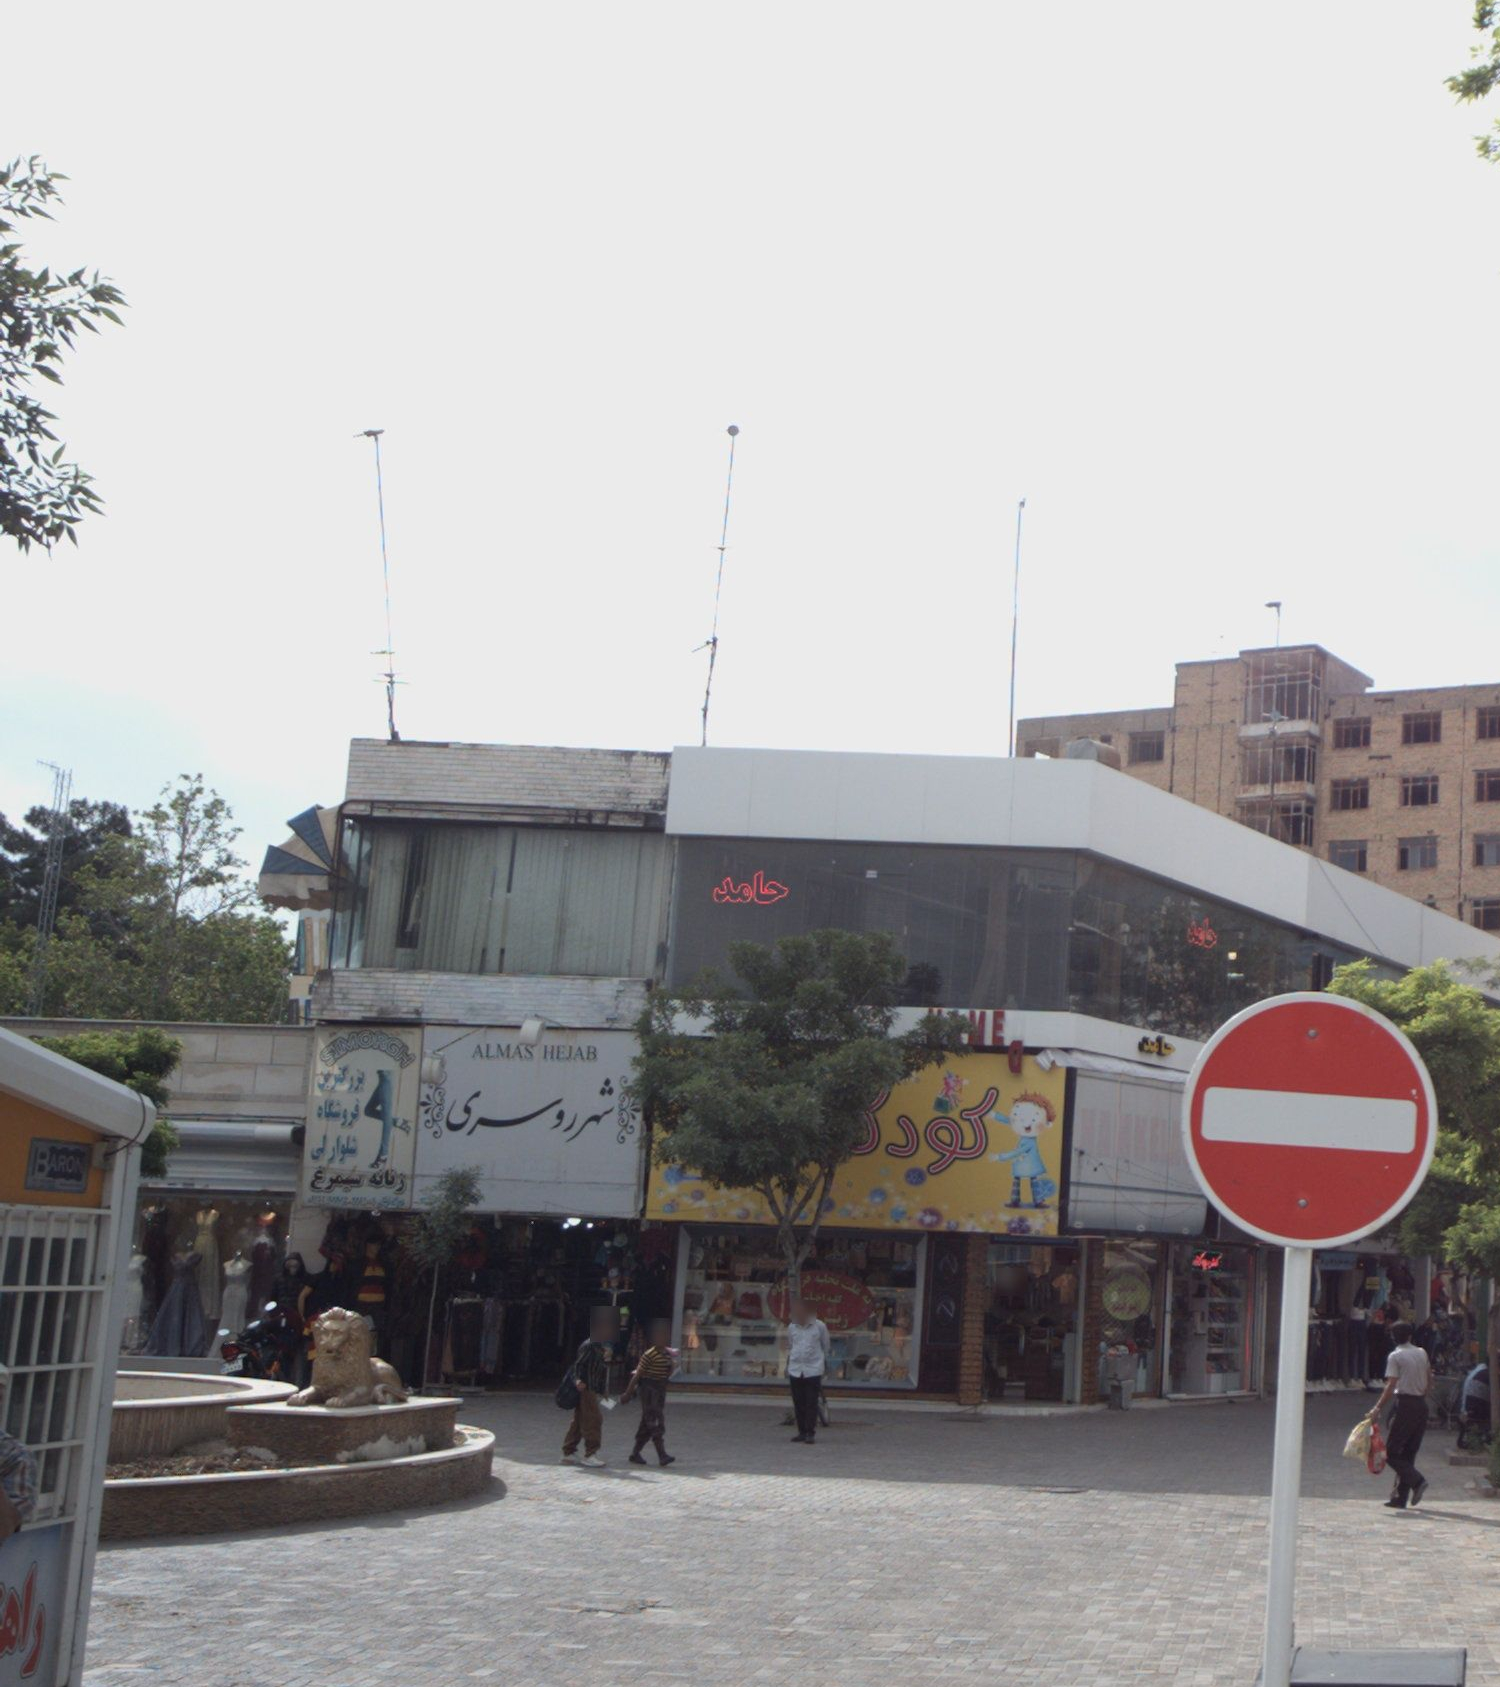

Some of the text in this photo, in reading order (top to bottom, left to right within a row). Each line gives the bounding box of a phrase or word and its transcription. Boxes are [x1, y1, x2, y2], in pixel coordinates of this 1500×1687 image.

[713, 870, 789, 904] حامد
[320, 1028, 416, 1069] SIMORGH
[471, 1043, 598, 1061] ALMAS HEJAB
[317, 1065, 365, 1092] بزرگترین
[317, 1098, 360, 1127] فروشگاه
[446, 1090, 578, 1136] روسری
[565, 1077, 614, 1143] شهر
[311, 1134, 358, 1164] شلوار لی
[310, 1166, 407, 1195] زنانه سیمرغ
